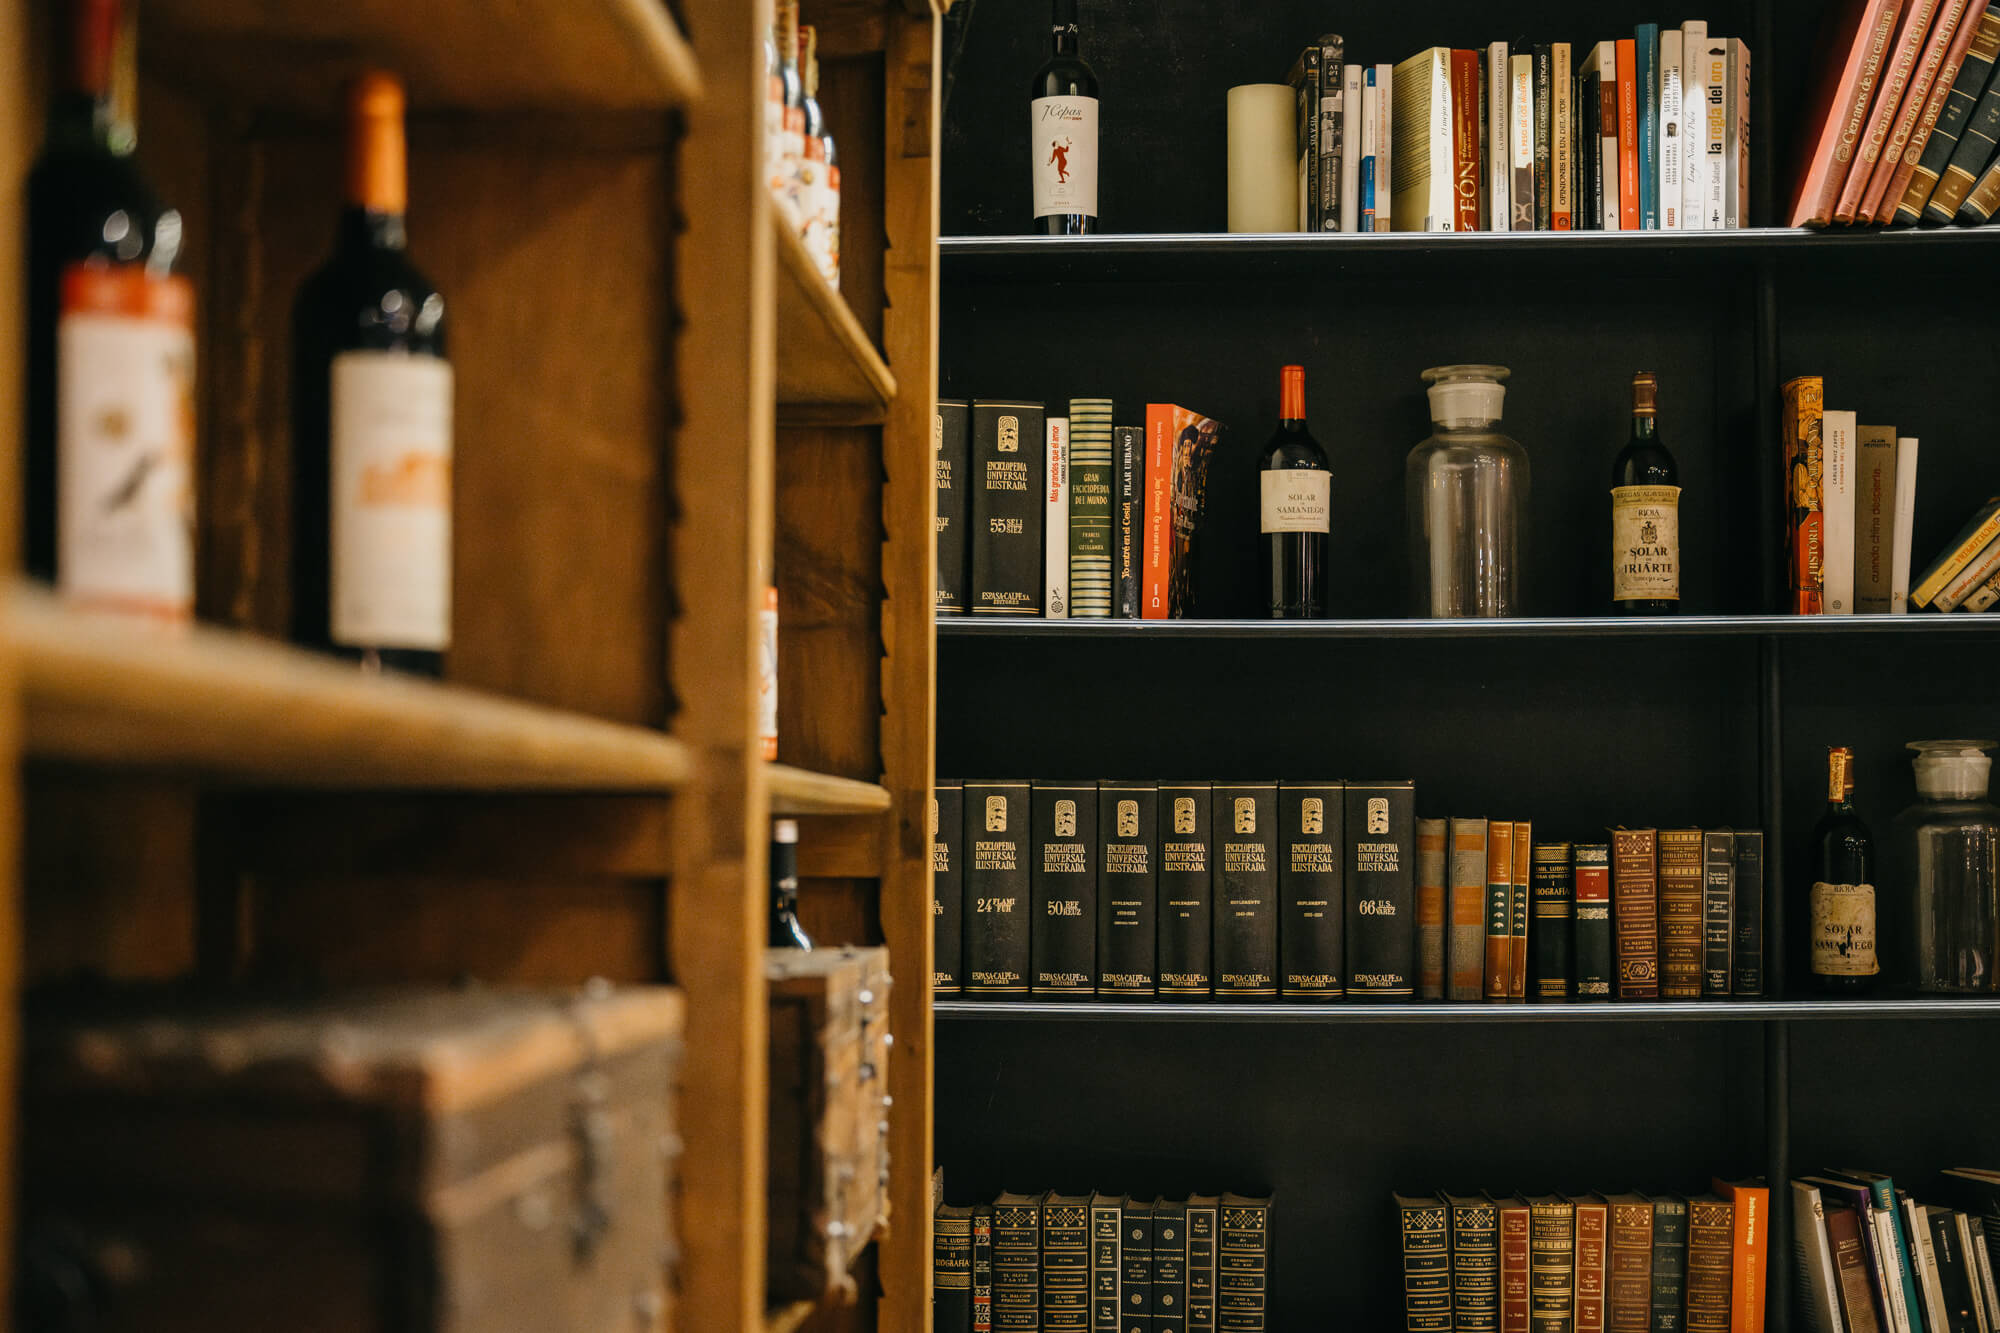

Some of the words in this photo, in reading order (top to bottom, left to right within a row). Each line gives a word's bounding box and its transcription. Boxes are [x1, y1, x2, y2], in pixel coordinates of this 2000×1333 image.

[1872, 10, 1894, 54] catalana
[1496, 49, 1504, 70] CHINA
[1539, 54, 1547, 85] VATICANO
[1711, 61, 1723, 82] oro
[1867, 54, 1881, 80] vida
[1519, 72, 1527, 103] MUERTOS
[1863, 76, 1874, 92] de
[1871, 121, 1888, 146] Cien
[1893, 80, 1903, 98] de
[1898, 70, 1907, 83] la
[1903, 48, 1917, 70] vida
[1911, 27, 1923, 49] del
[1894, 121, 1912, 146] Cien
[1915, 81, 1928, 97] de
[1922, 68, 1932, 82] la
[1928, 48, 1943, 69] vida
[1936, 28, 1949, 48] del
[1440, 80, 1448, 104] amigo
[1707, 85, 1722, 104] del
[1520, 104, 1528, 117] LOS
[1913, 126, 1929, 147] De
[1924, 96, 1942, 127] ayer
[1939, 85, 1947, 95] a
[1944, 63, 1959, 84] hoy
[1041, 104, 1051, 122] 7
[1051, 103, 1083, 120] Cepas
[1440, 105, 1448, 126] mejor
[1520, 119, 1528, 128] DE
[1707, 107, 1725, 140] regla
[1440, 127, 1447, 136] El
[1842, 121, 1860, 145] Cien
[1520, 129, 1528, 147] PESO
[1559, 136, 1566, 149] UN
[1559, 150, 1566, 160] DE
[1707, 143, 1722, 155] la
[1454, 160, 1476, 212] EÓN
[1051, 425, 1060, 442] amor
[1050, 449, 1060, 462] que
[1124, 435, 1132, 470] URBANO
[1807, 419, 1819, 488] CATALUNYA
[987, 461, 1027, 472] ENCICLOPEDIA
[987, 472, 1027, 481] UNIVERSAL
[1050, 463, 1060, 489] grandes
[1083, 473, 1100, 482] GRAN
[986, 481, 1027, 491] ILUSTRADA
[1072, 484, 1110, 494] ENCICLOPEDIA
[1124, 471, 1132, 496] PILAR
[1075, 496, 1086, 505] DEL
[1086, 496, 1108, 505] MUNDO
[1288, 493, 1317, 502] SOLAR
[1276, 505, 1325, 514] SAMANIEGO
[1808, 497, 1819, 512] DE
[1121, 502, 1131, 526] Cesid
[990, 518, 1006, 533] 55
[1122, 526, 1131, 535] el
[1870, 517, 1881, 544] china
[1123, 535, 1131, 546] en
[1121, 546, 1131, 567] entré
[1629, 547, 1667, 557] SOLAR
[1623, 563, 1673, 574] IRIARTE
[1871, 546, 1881, 584] cuando
[1121, 567, 1131, 579] Yo
[976, 841, 1017, 851] ENCICLOPEDIA
[1044, 843, 1086, 854] ENCICLOPEDIA
[1107, 844, 1148, 854] ENCICLOPEDIA
[1164, 842, 1205, 852] ENCICLOPEDIA
[1224, 843, 1266, 853] ENCICLOPEDIA
[1291, 843, 1333, 854] ENCICLOPEDIA
[1357, 843, 1399, 853] ENCICLOPEDIA
[976, 851, 1017, 860] UNIVERSAL
[1044, 853, 1086, 863] UNIVERSAL
[1106, 853, 1148, 864] UNIVERSAL
[1164, 852, 1205, 862] UNIVERSAL
[1224, 853, 1266, 863] UNIVERSAL
[1291, 853, 1333, 863] UNIVERSAL
[1357, 853, 1399, 863] UNIVERSAL
[975, 860, 1017, 870] ILUSTRADA
[1043, 863, 1086, 873] ILUSTRADA
[1106, 863, 1148, 874] ILUSTRADA
[1164, 862, 1205, 872] ILUSTRADA
[1224, 862, 1266, 872] ILUSTRADA
[1291, 862, 1333, 873] ILUSTRADA
[1357, 862, 1399, 872] ILUSTRADA
[977, 897, 992, 913] 24
[1047, 900, 1064, 916] 50
[1359, 900, 1376, 916] 66
[1746, 1218, 1756, 1246] Irving
